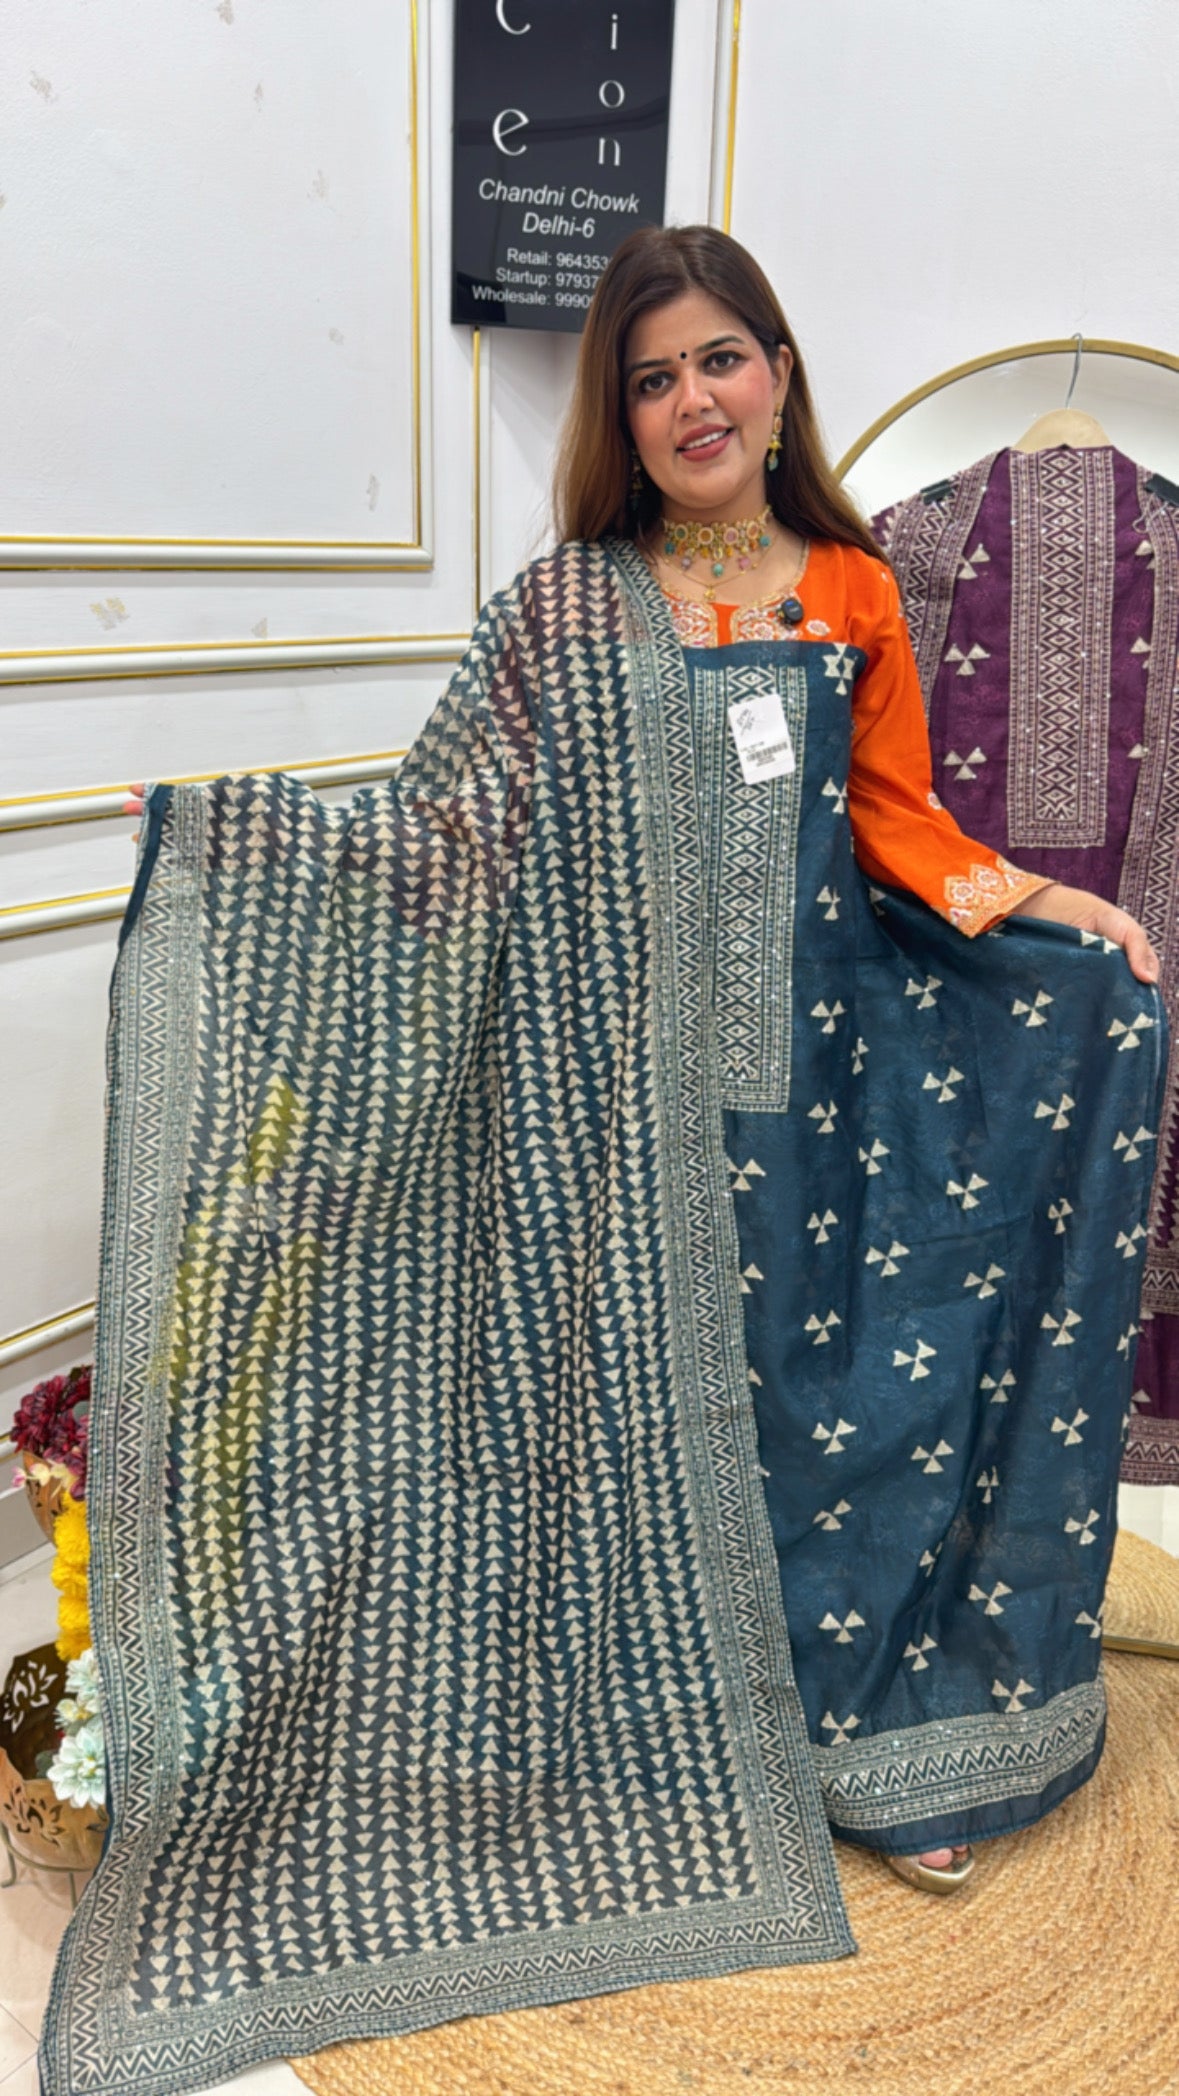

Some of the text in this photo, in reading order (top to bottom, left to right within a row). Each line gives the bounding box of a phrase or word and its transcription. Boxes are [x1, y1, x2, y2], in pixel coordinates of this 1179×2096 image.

[478, 178, 640, 214] Chandni Chowk
[521, 212, 596, 238] Delhi-6
[506, 247, 613, 271] Retail: 964353
[495, 267, 551, 288] Startup:
[472, 285, 595, 309] Wholesale: 9990
